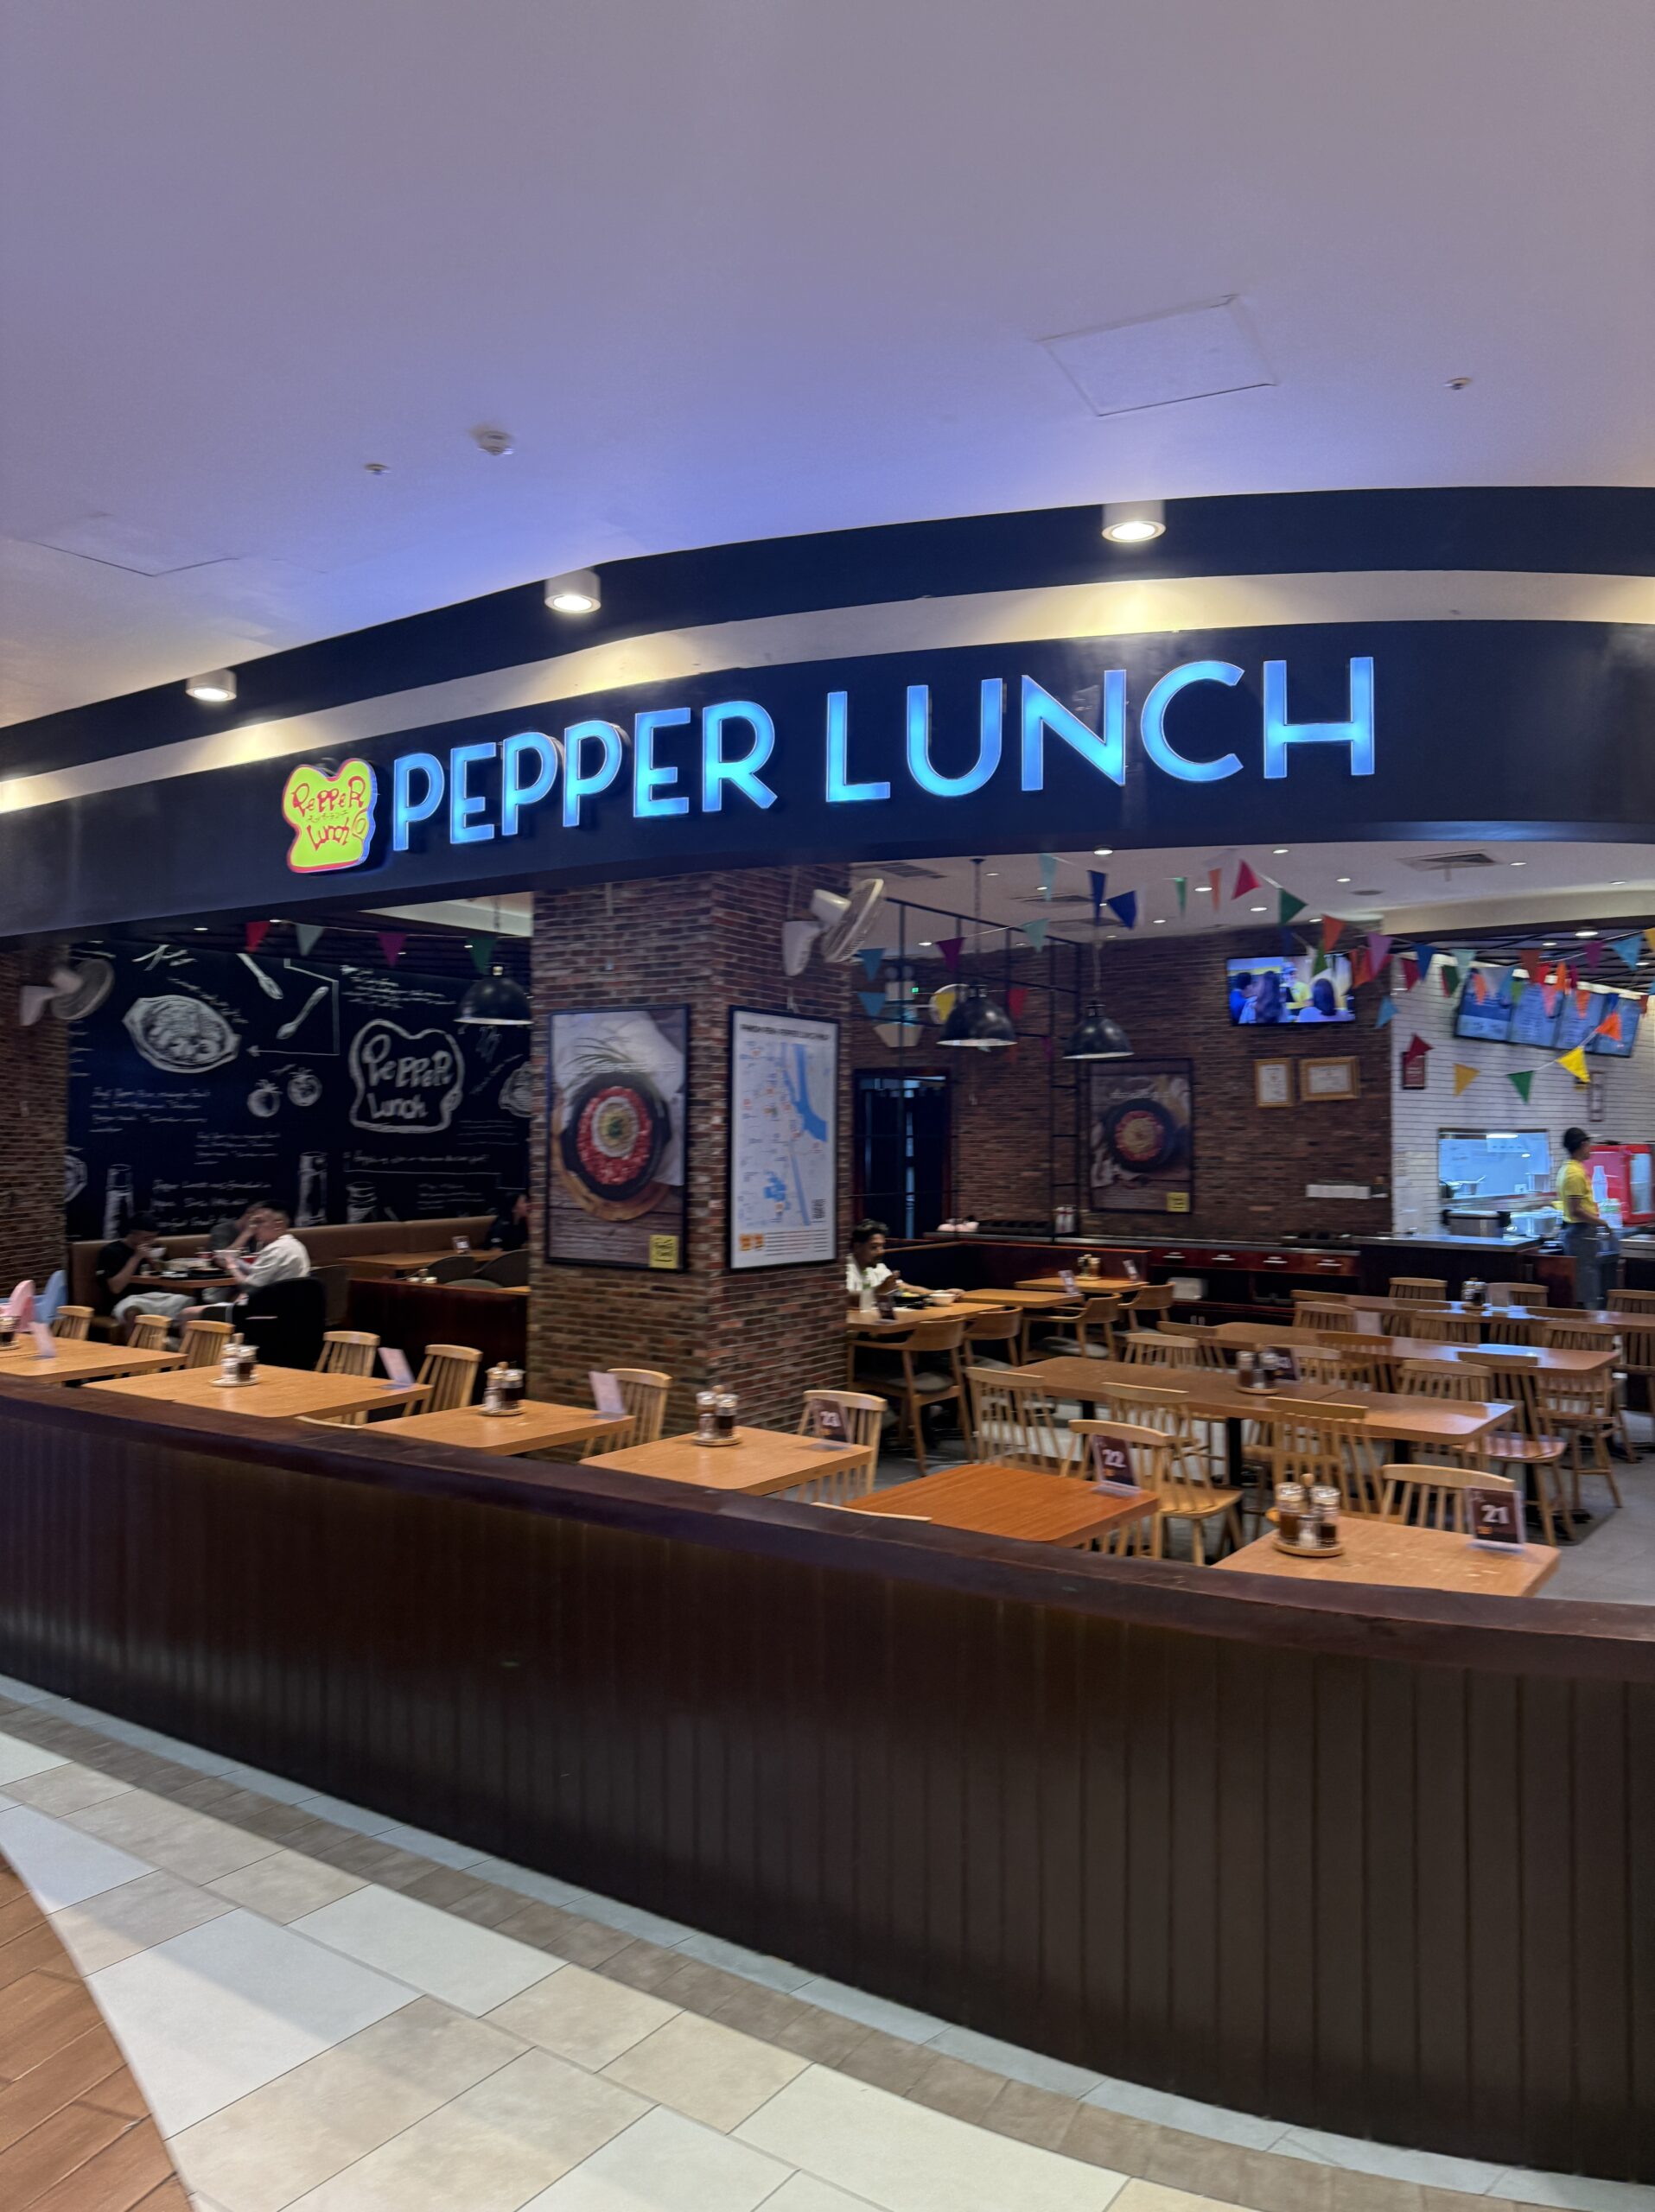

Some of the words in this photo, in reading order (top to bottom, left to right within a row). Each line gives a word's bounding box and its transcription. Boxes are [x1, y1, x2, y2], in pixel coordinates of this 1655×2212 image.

[392, 700, 778, 852] PEPPER
[825, 656, 1376, 804] LUNCH
[1101, 1448, 1128, 1468] 22
[1480, 1503, 1511, 1524] 21
